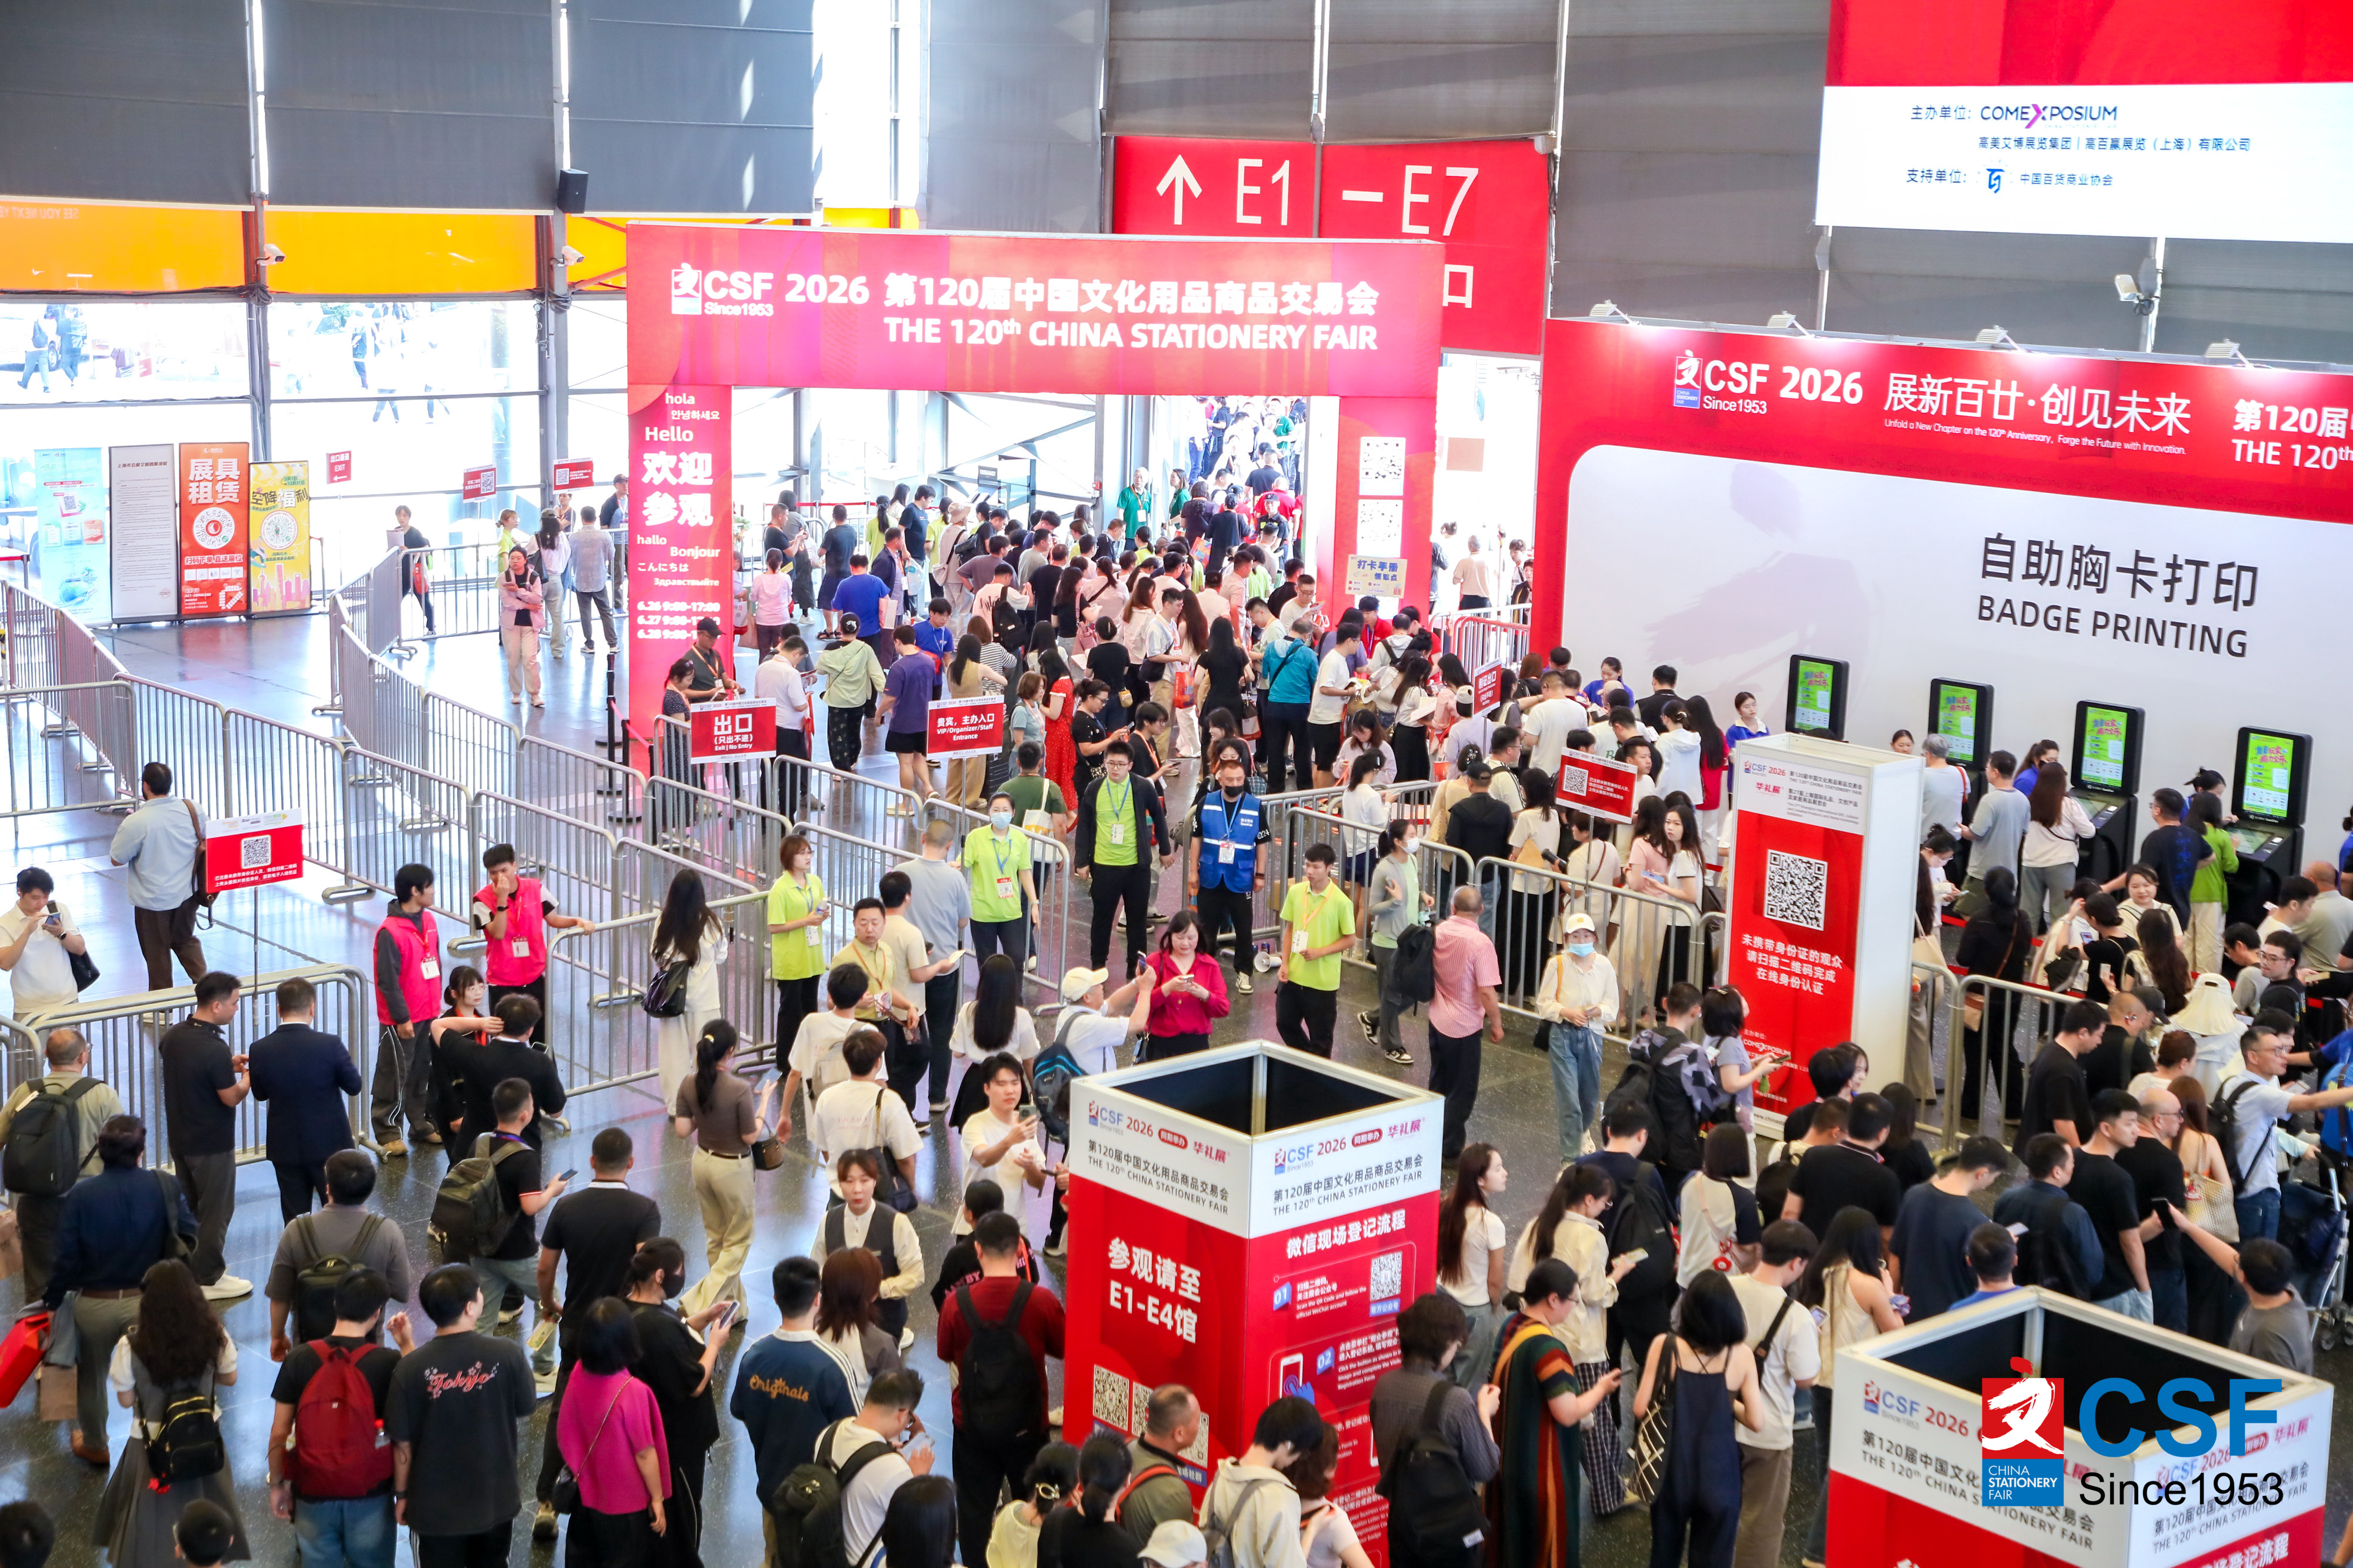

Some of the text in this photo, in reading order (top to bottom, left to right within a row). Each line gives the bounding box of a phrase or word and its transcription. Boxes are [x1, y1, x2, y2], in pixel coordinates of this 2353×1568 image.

[1980, 104, 2118, 129] COMEXPOSIUM
[1237, 158, 1479, 236] E1 E7
[705, 270, 869, 305] CSF 2026
[884, 272, 1379, 316] 第120届中国文化用品商品交易会
[705, 301, 774, 317] Since1953
[884, 317, 1378, 351] THE 120th CHINA STATIONERY FAIR
[1704, 359, 1864, 405] CSF 2026
[665, 392, 695, 405] hola
[1702, 395, 1768, 415] Since1953
[1884, 372, 2191, 437] 展新百廿·创见未来
[671, 410, 720, 421] 안녕하세요
[2232, 398, 2353, 439] 第120届
[645, 426, 694, 442] Hello
[1884, 418, 1908, 429] Unfold
[1915, 421, 1932, 431] New
[1933, 422, 1962, 436] Chapter
[1974, 426, 1987, 436] the
[2007, 429, 2054, 445] Anniversary,
[2057, 435, 2080, 448] Forge
[2081, 437, 2095, 447] the
[2096, 438, 2122, 449] Future
[2123, 441, 2141, 451] with
[2142, 442, 2187, 455] Innovation.
[2231, 439, 2282, 465] THE
[188, 458, 241, 481] 展具
[641, 451, 714, 485] 欢迎
[188, 481, 240, 505] 租赁
[251, 488, 309, 509] 空降福利
[642, 491, 714, 527] 参观
[637, 534, 667, 545] hallo
[669, 546, 721, 559] Bonjour
[638, 562, 689, 572] こんにちは
[1357, 559, 1399, 572] 打卡手册
[1981, 532, 2259, 612] 自助胸卡打印
[637, 600, 662, 611] 6.26
[637, 615, 662, 625] 6.27
[1978, 594, 2248, 658] BADGE PRINTING
[714, 713, 753, 736] 出口
[936, 723, 994, 735] VIP/Organizer/Staff
[1751, 763, 1786, 776] CSF 2026
[1741, 933, 1844, 970] 未携带身份证的观众
[1747, 949, 1837, 983] 请扫描二维码完成
[1756, 967, 1824, 996] 在线身份认证
[1099, 1107, 1154, 1138] CSF 2026
[1287, 1137, 1347, 1163] CSF 2026
[1354, 1130, 1380, 1145] 同期举办
[1088, 1139, 1229, 1203] 第120届中国文化用品商品交易会
[1273, 1154, 1423, 1203] 第120届中国文化用品商品交易会
[1088, 1155, 1228, 1216] THE 120th CHINA STATIONERY FAIR
[1273, 1170, 1422, 1217] THE 120th CHINA STATIONERY FAIR
[1286, 1208, 1406, 1259] 微信现场登记流程
[1108, 1236, 1201, 1303] 参观请至
[1275, 1289, 1287, 1305] 01
[1296, 1300, 1348, 1320] official WeChat account
[1297, 1302, 1308, 1310] Scan
[1324, 1295, 1335, 1303] Code
[1345, 1288, 1359, 1297] follow
[1109, 1279, 1198, 1344] E1-E4馆
[1318, 1350, 1332, 1369] 02
[1357, 1359, 1372, 1367] button
[427, 1371, 492, 1392] Tokyo
[749, 1374, 809, 1402] Originals
[1882, 1391, 1969, 1437] CSF 2026
[1862, 1450, 2093, 1551] THE CHINA FAIR
[2288, 1482, 2308, 1500] FAIR
